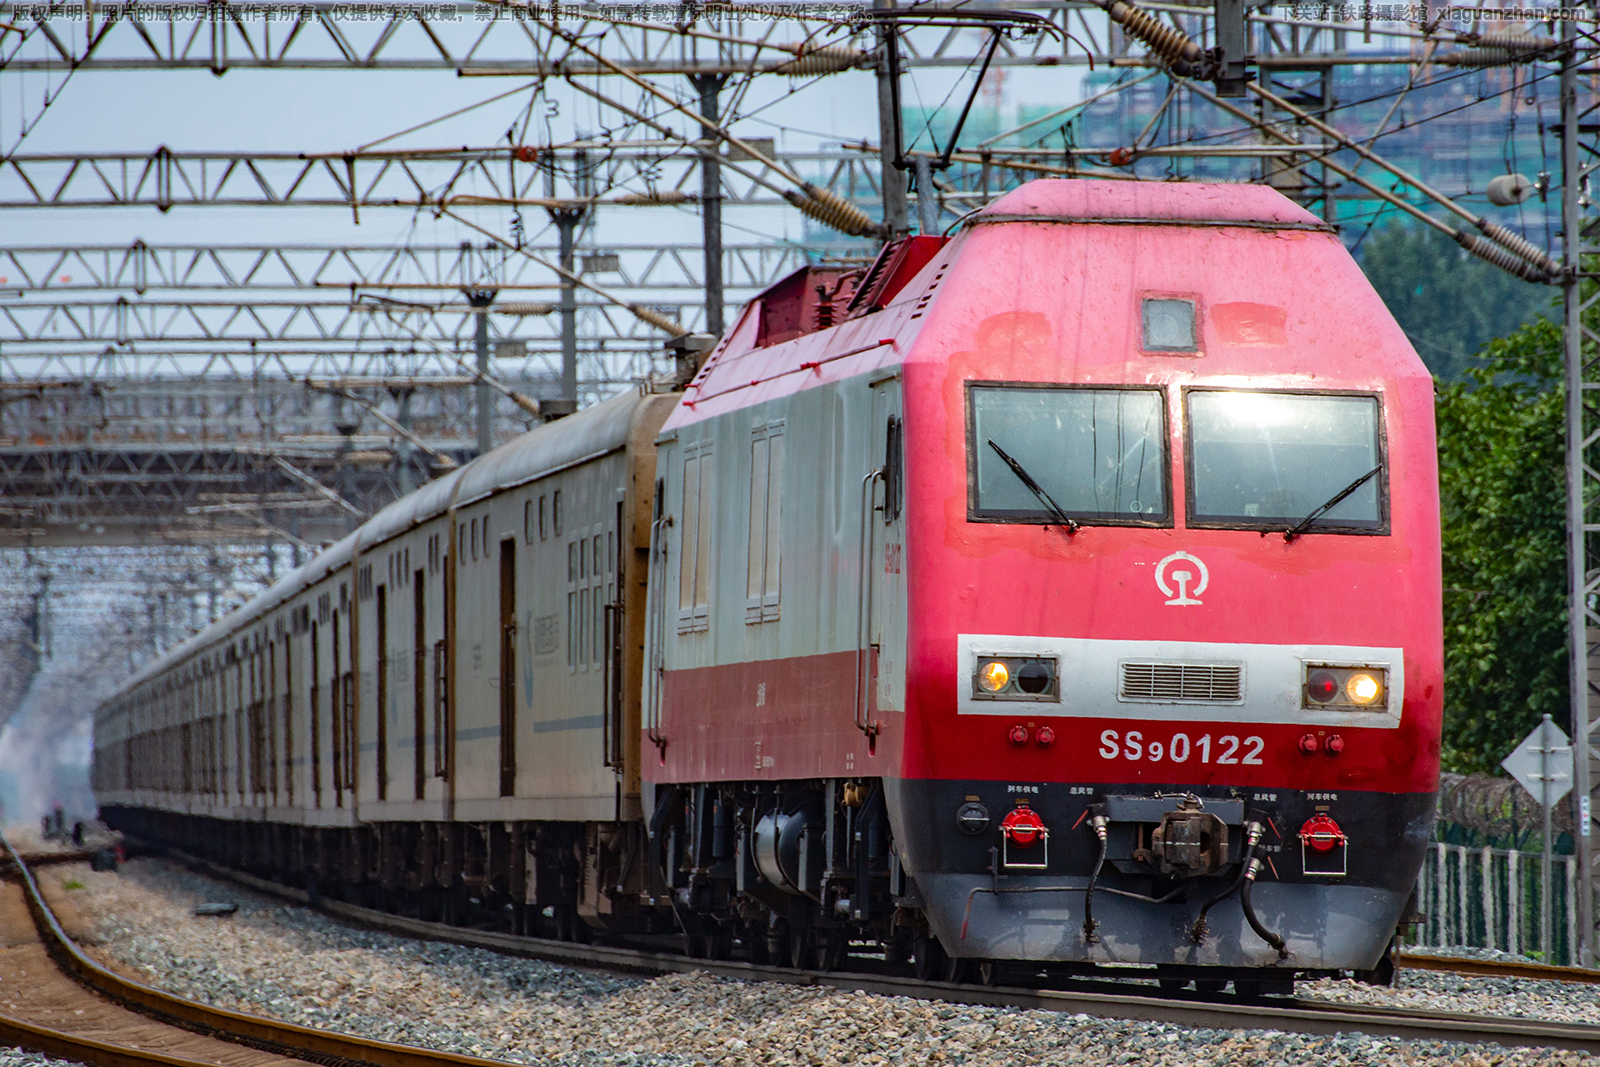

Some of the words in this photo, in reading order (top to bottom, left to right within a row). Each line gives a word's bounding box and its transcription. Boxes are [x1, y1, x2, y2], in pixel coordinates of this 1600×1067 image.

[1007, 785, 1039, 794] 列车供电
[1069, 787, 1094, 795] 总风管
[1253, 793, 1278, 802] 总风管
[1306, 793, 1338, 801] 列车供电
